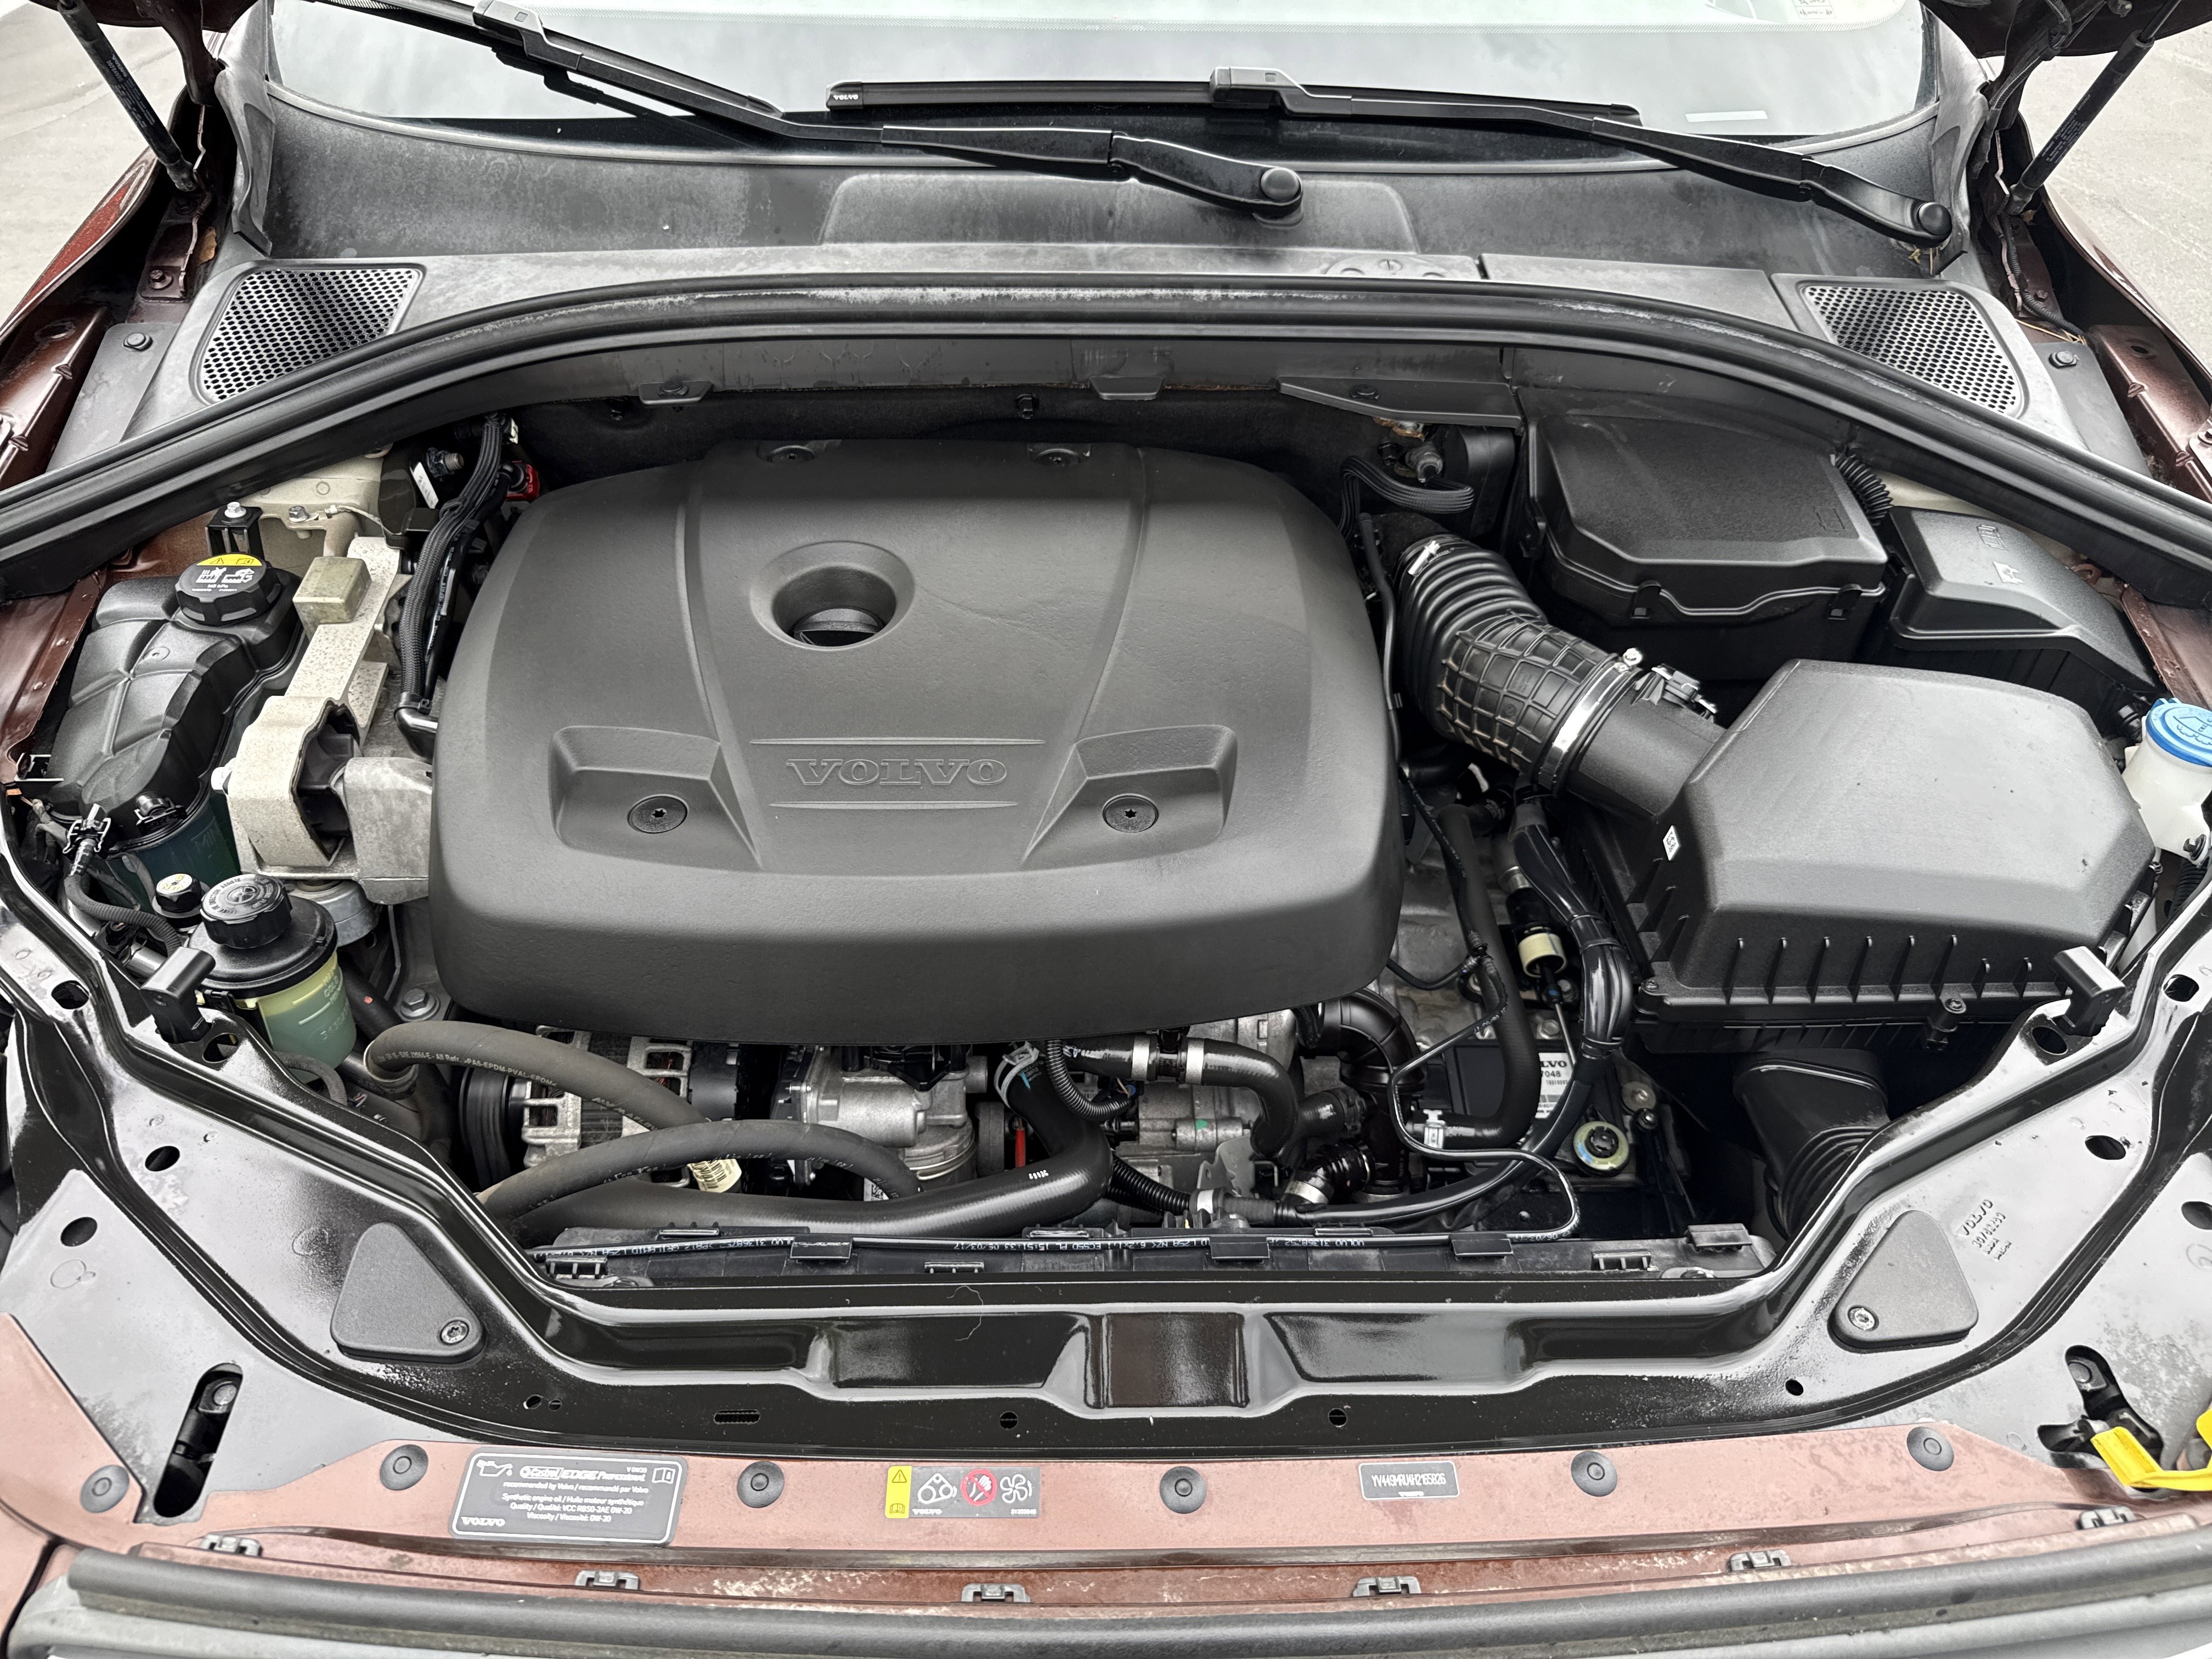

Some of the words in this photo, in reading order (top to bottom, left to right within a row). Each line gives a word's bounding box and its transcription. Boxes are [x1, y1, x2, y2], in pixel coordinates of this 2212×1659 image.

[785, 758, 1008, 786] VOLVO
[1956, 1199, 1994, 1237] VOLVO
[1335, 1238, 1364, 1246] VOLVO
[530, 1467, 560, 1479] Castrol
[560, 1469, 599, 1480] EDGE
[503, 1481, 548, 1489] recommended
[549, 1482, 557, 1491] by
[557, 1482, 574, 1491] Volvo
[578, 1484, 619, 1493] recommandé
[632, 1486, 649, 1494] Volvo
[501, 1492, 532, 1502] Synthetic
[532, 1494, 552, 1504] engine
[567, 1496, 584, 1504] Huile
[584, 1497, 607, 1505] moteur
[510, 1502, 533, 1512] Quality
[562, 1504, 577, 1513] VCC
[461, 1516, 506, 1527] VOLVO
[527, 1511, 555, 1521] Viscosity
